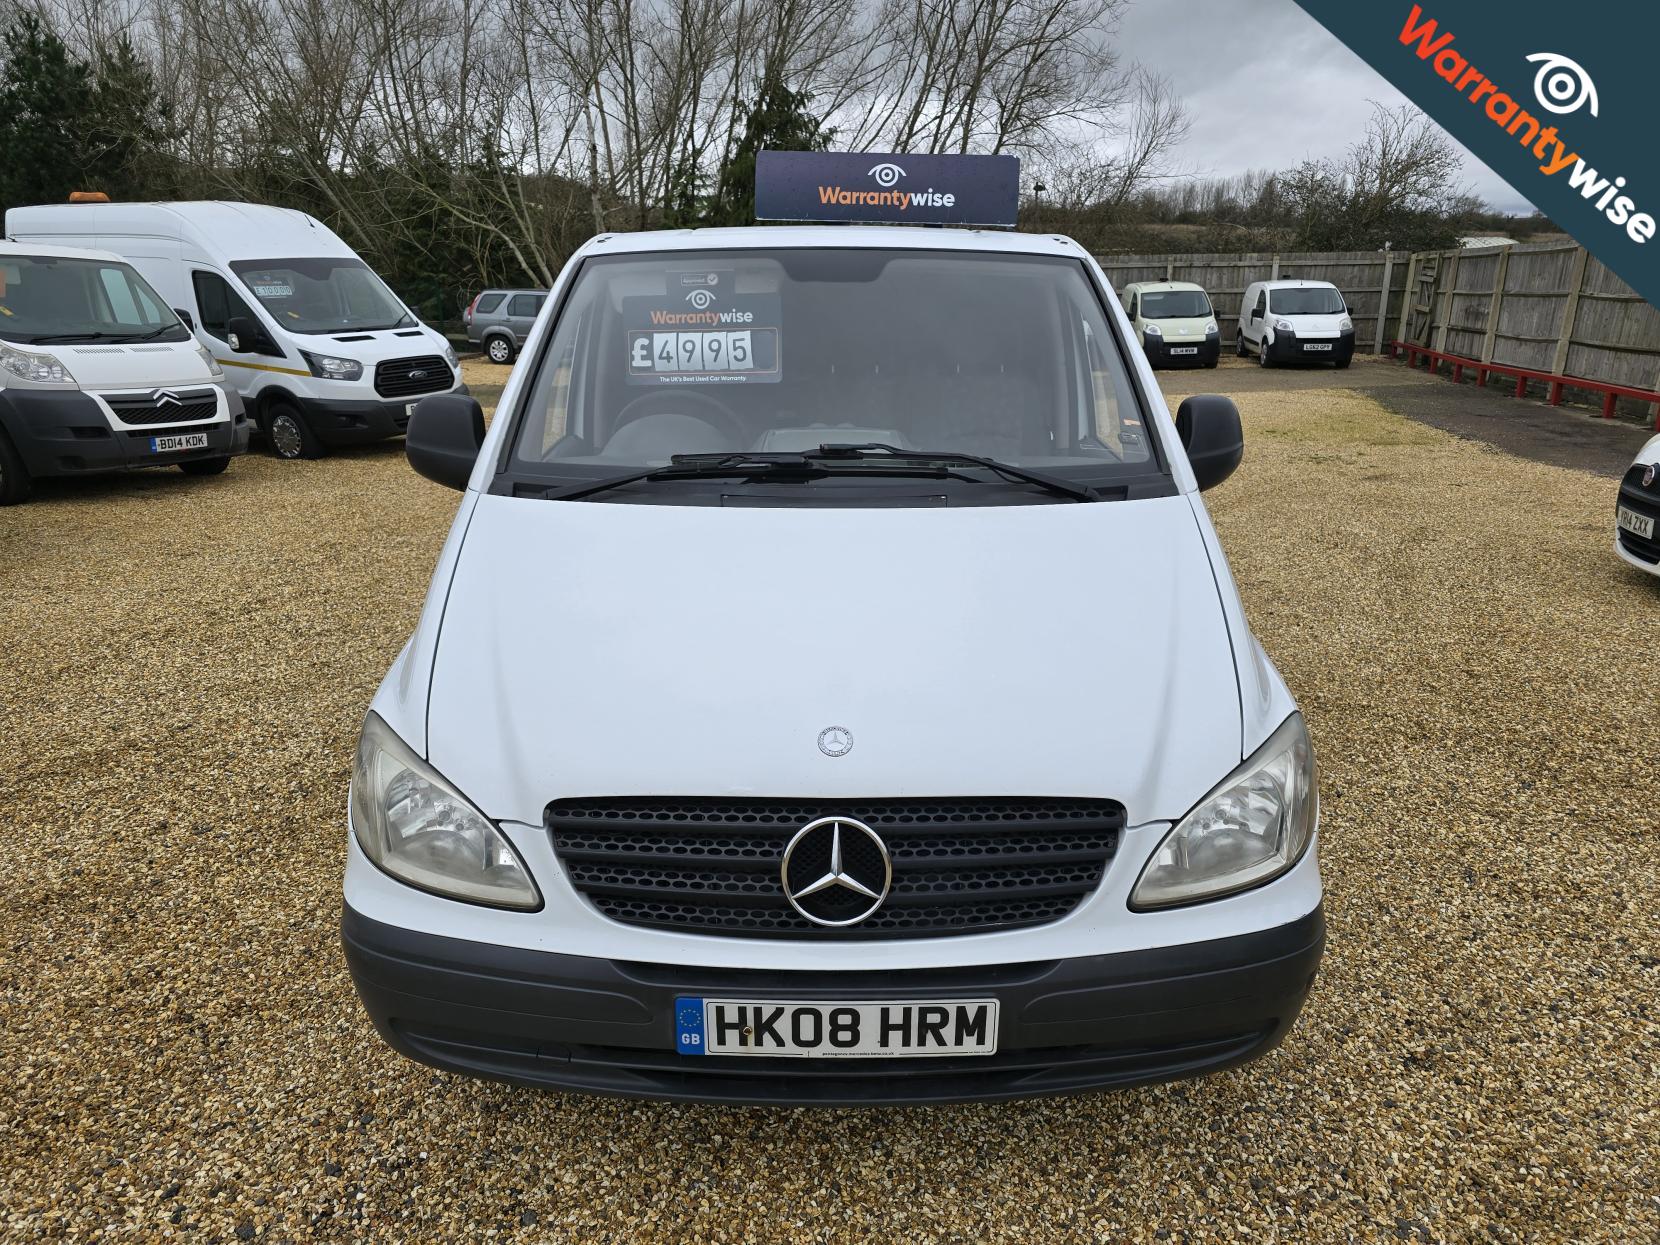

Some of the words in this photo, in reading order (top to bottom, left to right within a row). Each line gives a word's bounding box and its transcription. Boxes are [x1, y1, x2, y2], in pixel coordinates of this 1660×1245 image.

[818, 186, 955, 210] Warrantywise
[650, 309, 754, 326] Warrantywise
[160, 438, 183, 450] BD14
[185, 435, 204, 447] KDK
[1633, 515, 1649, 535] ZXX
[715, 1005, 861, 1047] HK08
[879, 1005, 988, 1047] HRM
[681, 1033, 701, 1045] GB
